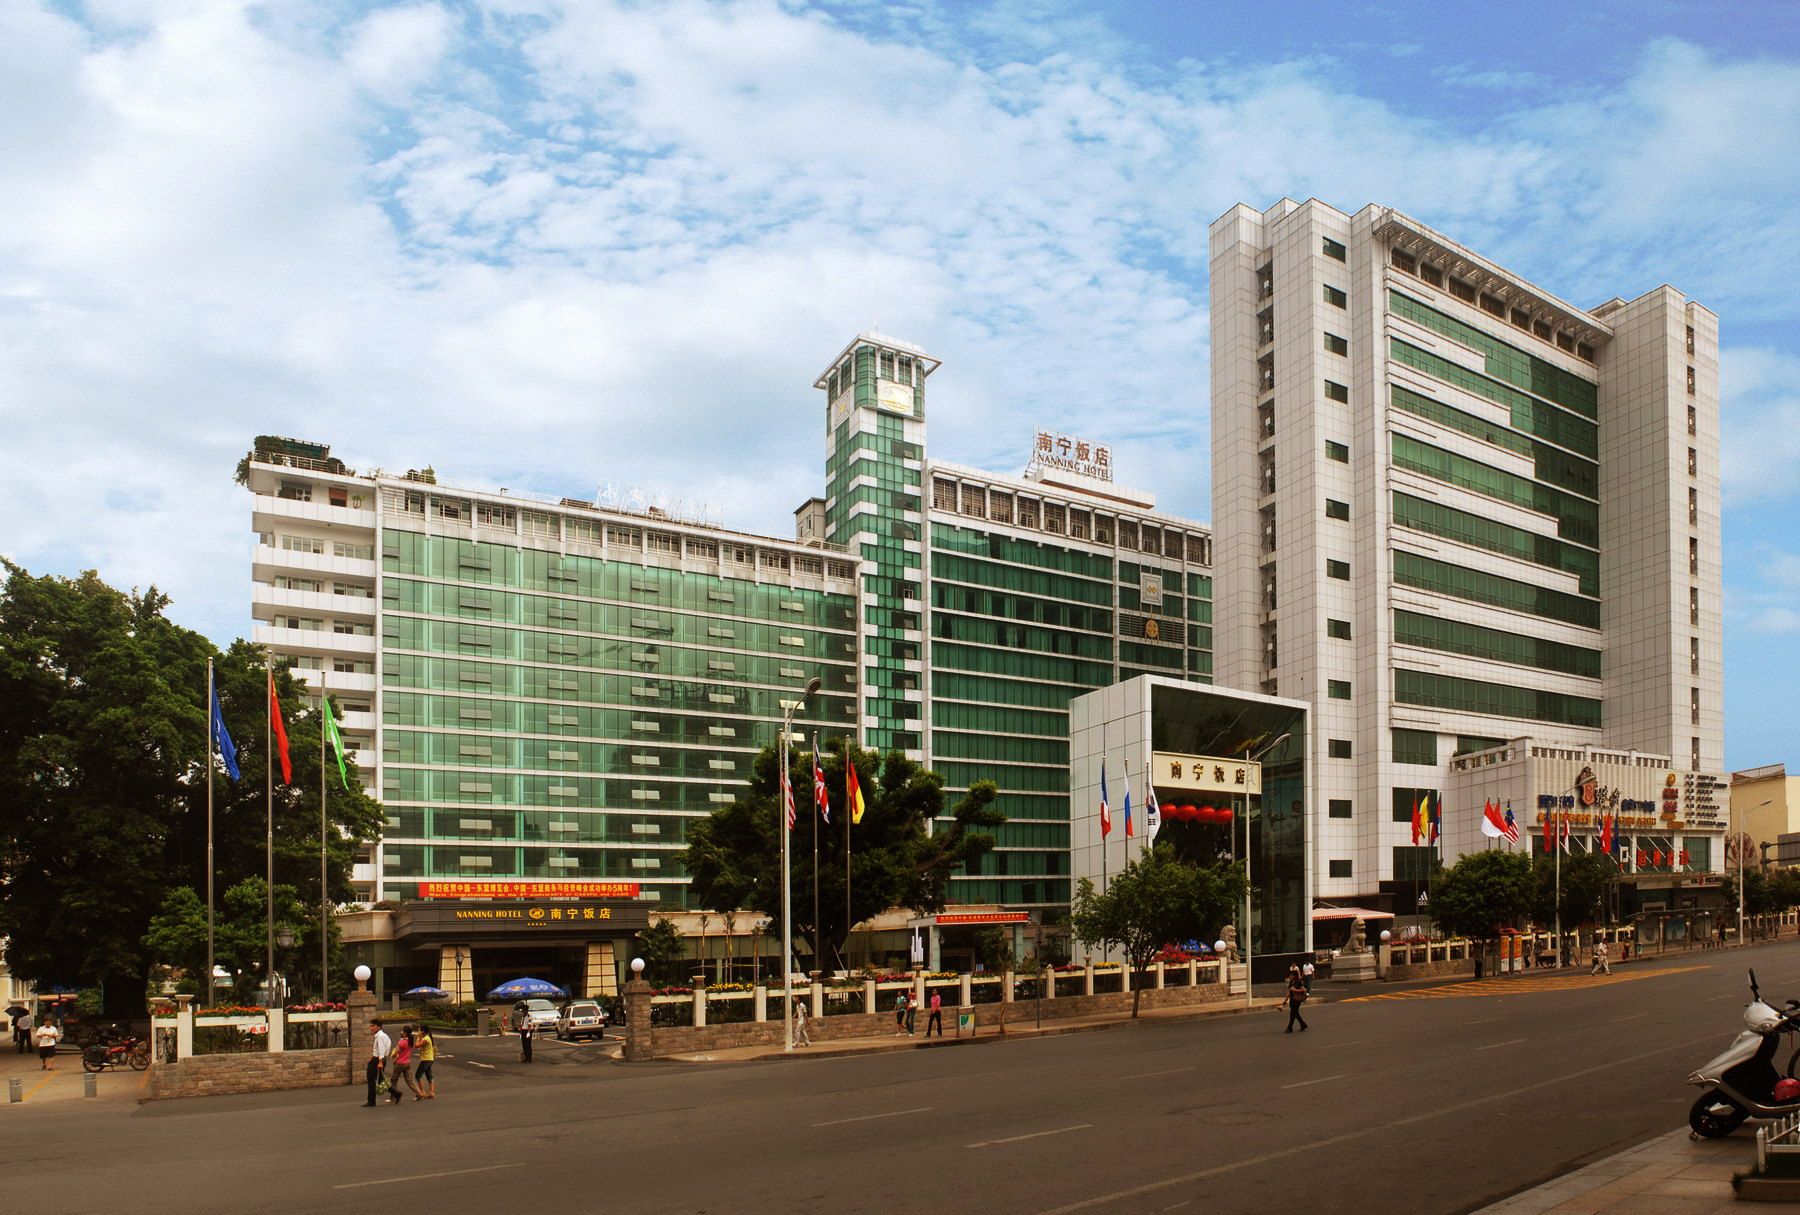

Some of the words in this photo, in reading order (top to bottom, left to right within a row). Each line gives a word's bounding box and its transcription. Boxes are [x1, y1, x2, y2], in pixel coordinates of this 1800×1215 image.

[1038, 432, 1109, 467] 南宁饭店
[1038, 454, 1080, 471] NANNING
[1084, 465, 1110, 479] HOTEL
[1170, 761, 1246, 785] 南宁饭店
[456, 910, 493, 919] NANNING
[495, 910, 523, 918] HOTEL
[550, 908, 611, 919] 南宁饭店
